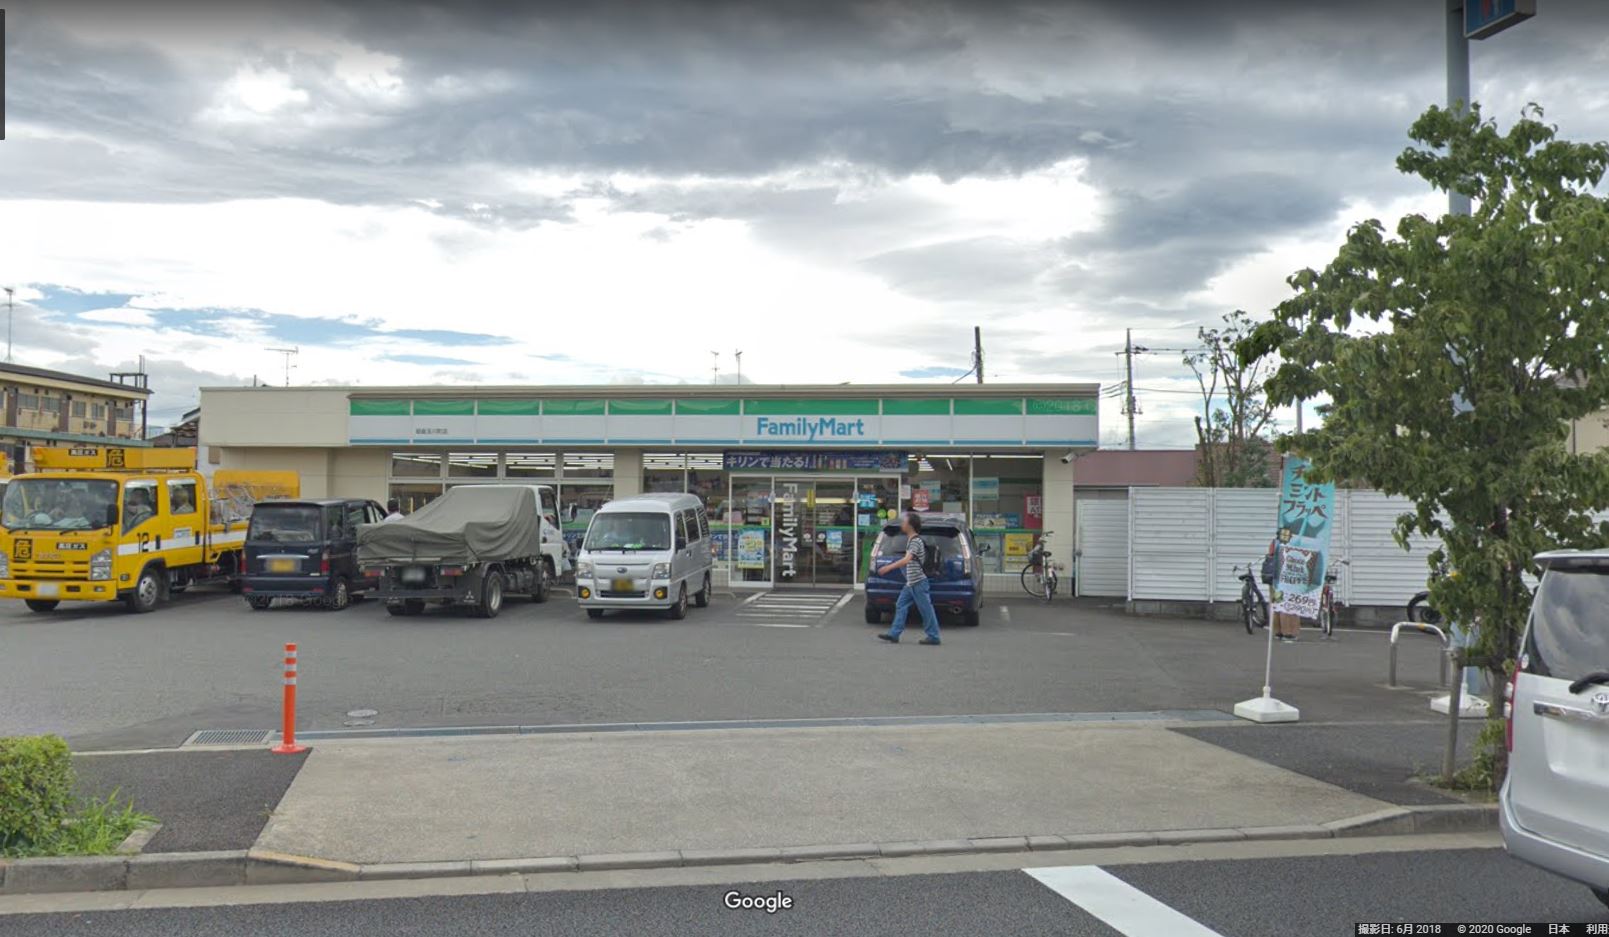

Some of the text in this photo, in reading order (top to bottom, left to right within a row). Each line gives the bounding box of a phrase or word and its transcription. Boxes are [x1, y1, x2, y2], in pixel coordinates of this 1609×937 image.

[757, 417, 864, 440] FamilyMart
[107, 449, 124, 468] 危
[1289, 483, 1326, 503] ミント
[1283, 499, 1329, 520] フラッペ
[779, 483, 799, 577] FamilyMart
[15, 540, 31, 558] 危
[137, 532, 149, 552] 12
